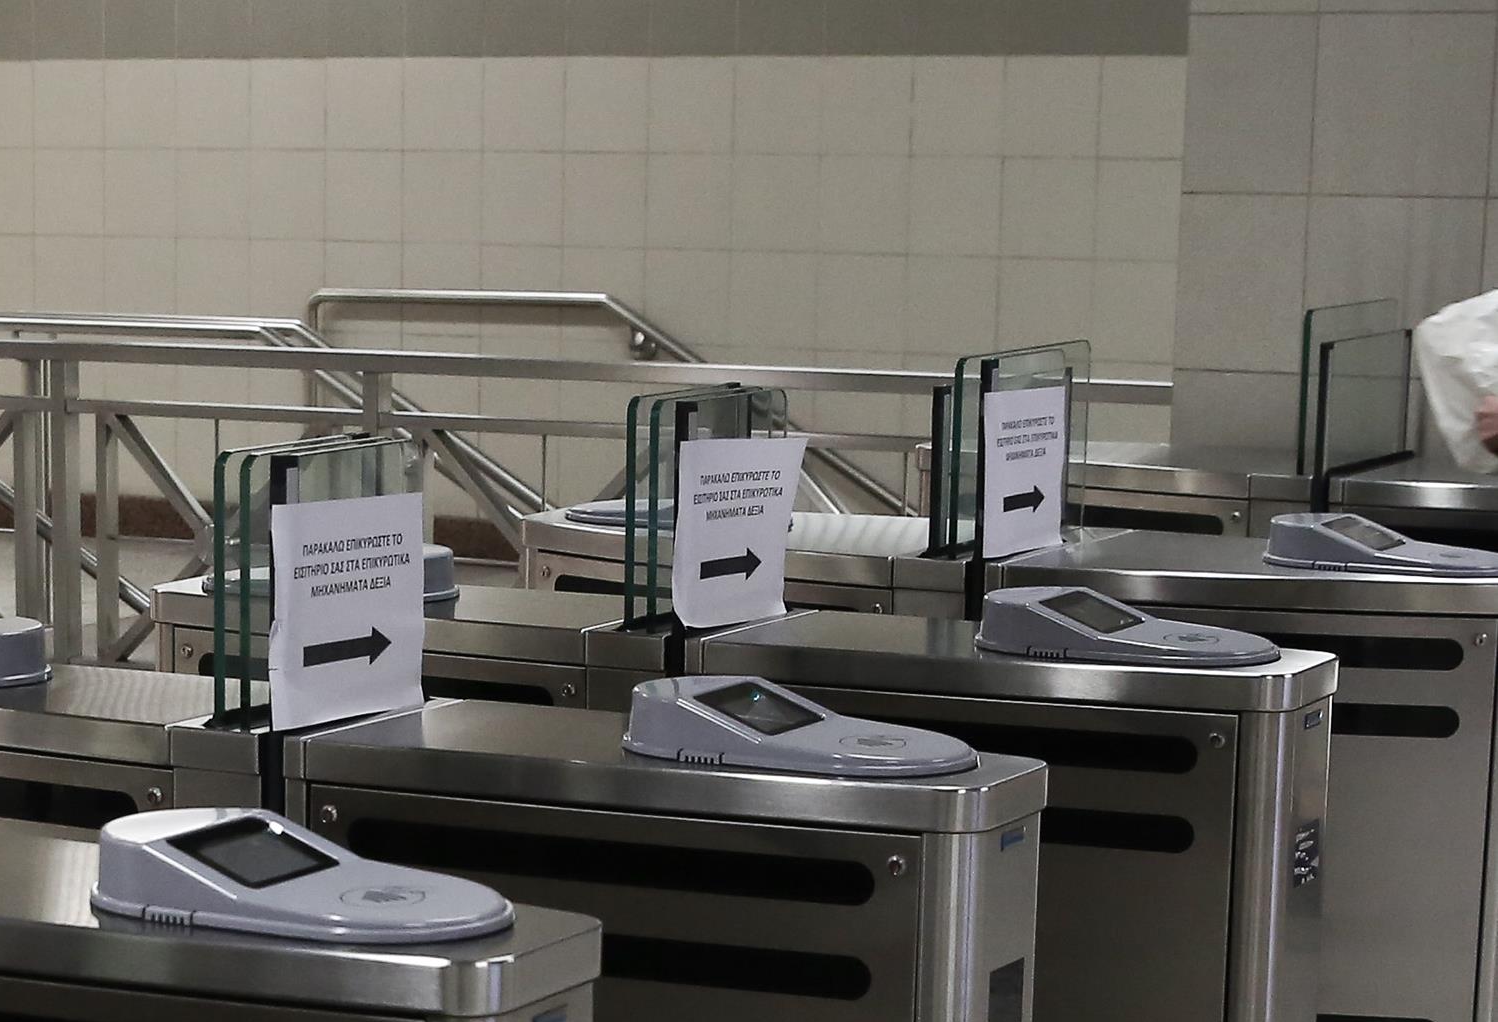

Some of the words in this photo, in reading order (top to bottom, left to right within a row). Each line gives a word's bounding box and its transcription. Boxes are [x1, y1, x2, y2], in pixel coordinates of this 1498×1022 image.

[771, 470, 781, 481] ΤΟ
[302, 539, 345, 557] ΠΑΡΑΚΑΛΩ
[346, 534, 390, 552] ΕΠΙΚΥΡΩΣΤΕ
[392, 533, 403, 546] ΤΟ
[330, 560, 345, 575] ΣΑΣ
[346, 559, 361, 573] ΣΤΑ
[362, 553, 411, 571] ΕΠΙΚΥΡΩΤΙΚΑ
[370, 576, 391, 590] ΔΕΞΙΑ
